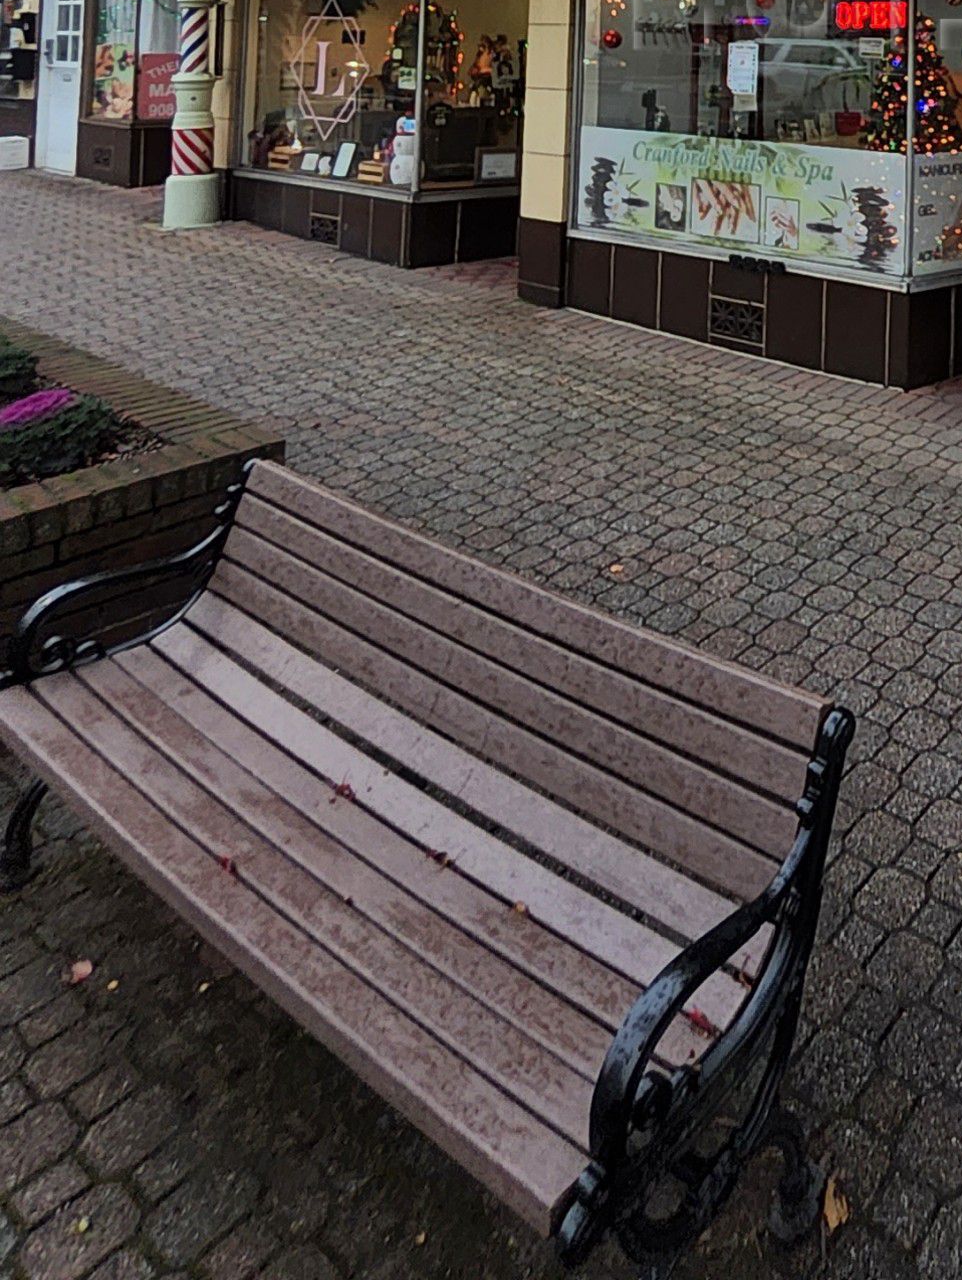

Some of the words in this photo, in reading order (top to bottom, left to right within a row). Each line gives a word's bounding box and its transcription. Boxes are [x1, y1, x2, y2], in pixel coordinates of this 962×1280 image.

[835, 1, 907, 31] OPEN
[632, 140, 710, 168] Cranford
[717, 145, 767, 173] Nails
[794, 156, 834, 186] Spa
